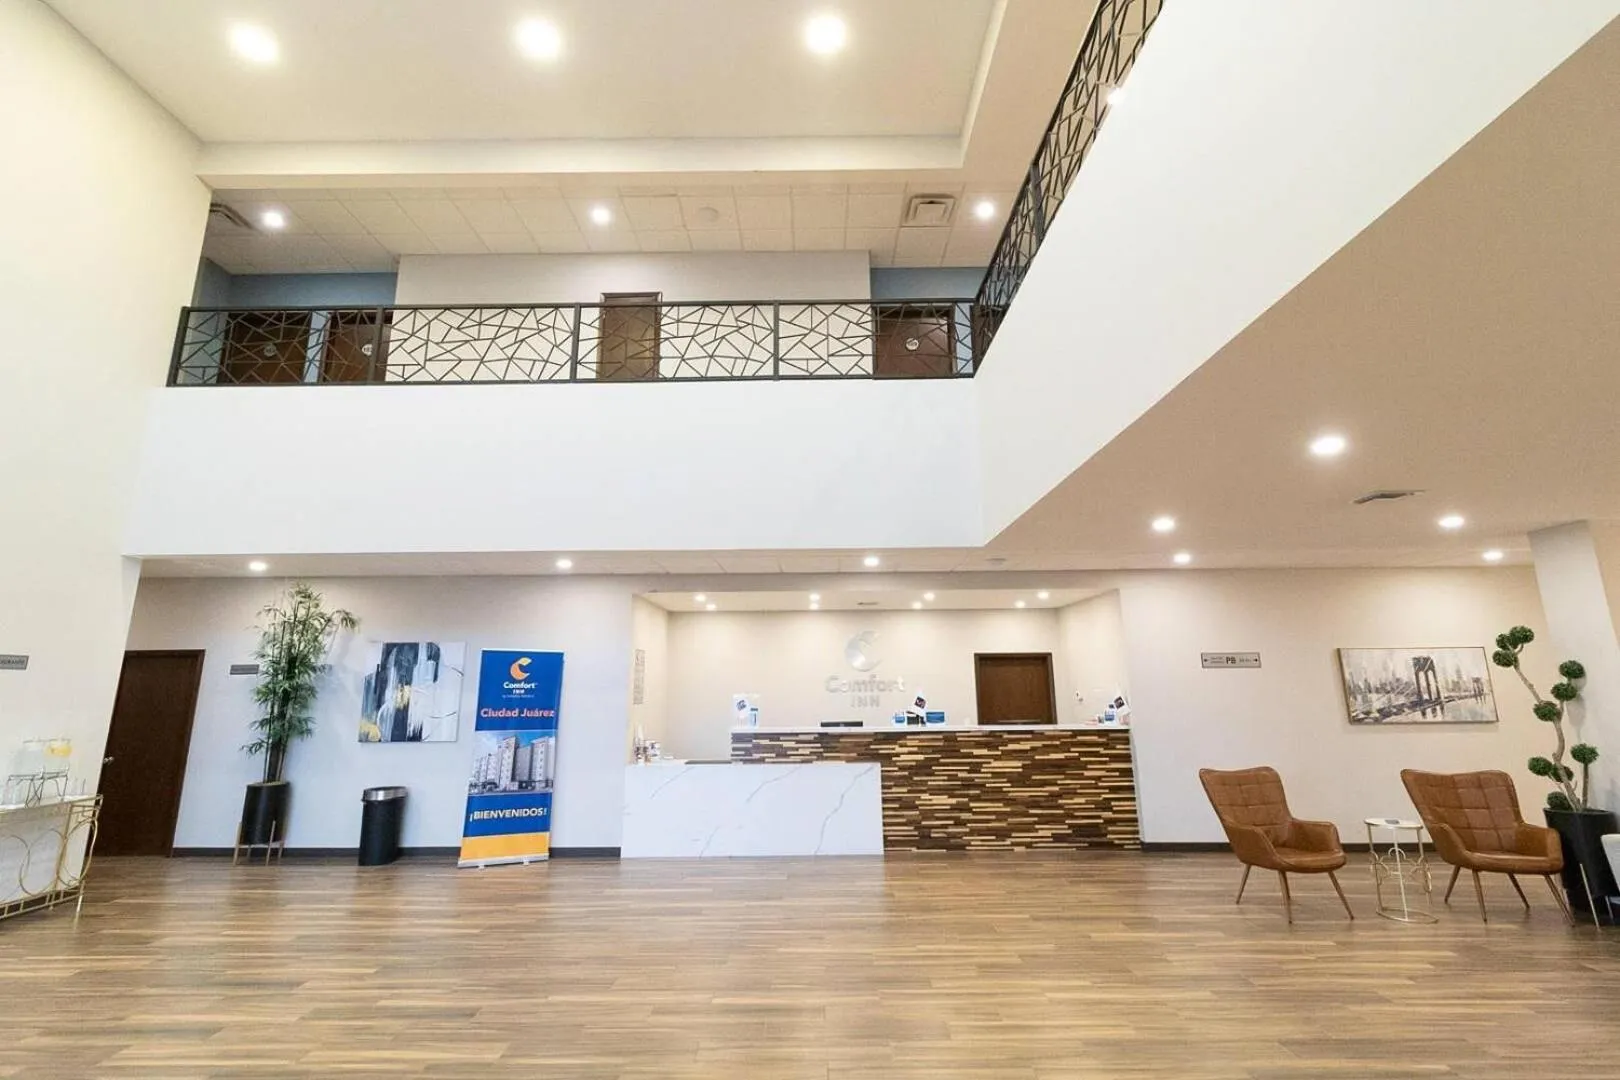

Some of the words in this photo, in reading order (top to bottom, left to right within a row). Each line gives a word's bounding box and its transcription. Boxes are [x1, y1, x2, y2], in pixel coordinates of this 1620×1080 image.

[503, 681, 535, 689] Comfort
[825, 675, 905, 693] Comfort
[850, 695, 880, 707] INN
[480, 707, 519, 717] Ciudad
[520, 707, 556, 717] Juárez
[469, 807, 548, 822] ¡BIENVENIDOS!
